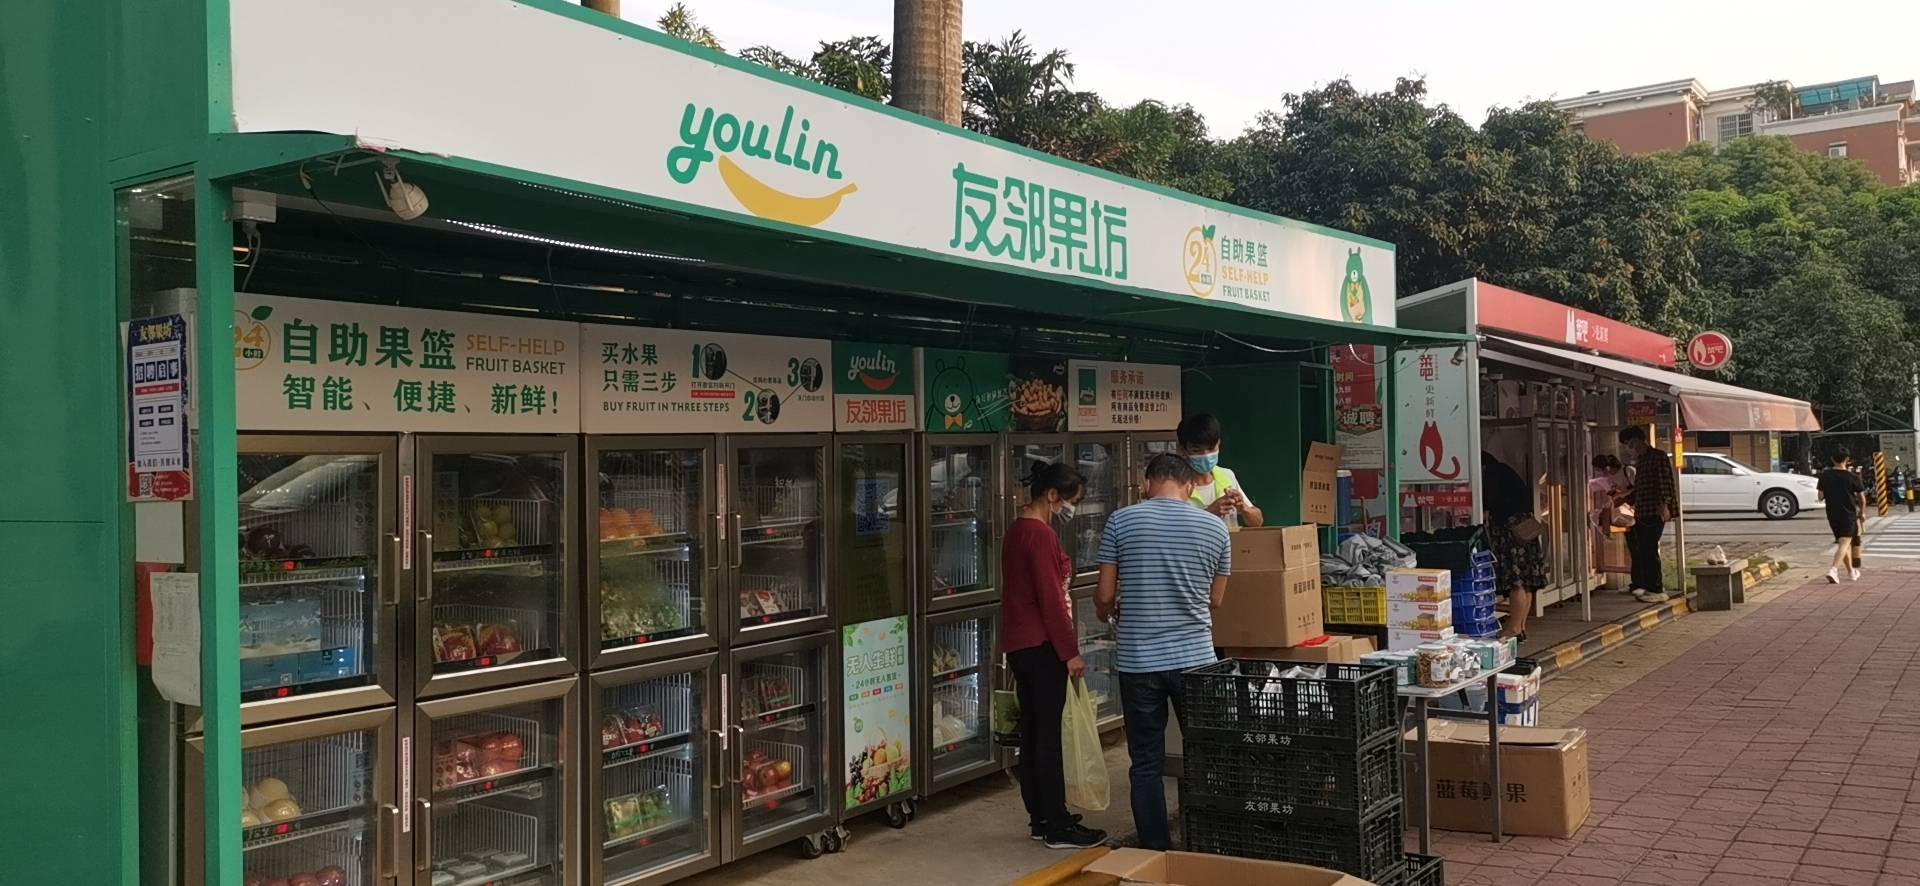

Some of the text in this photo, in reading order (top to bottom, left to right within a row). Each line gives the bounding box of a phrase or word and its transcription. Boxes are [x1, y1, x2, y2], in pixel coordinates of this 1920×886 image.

[667, 103, 842, 184] youlin
[950, 162, 1128, 280] 友邻果坊
[1221, 235, 1269, 268] 自助果篮
[1222, 267, 1270, 286] SELF-HELP
[1222, 285, 1271, 302] FRUIT BASKET
[284, 318, 456, 370] 自助果篮
[466, 334, 565, 356] SELF-HELP
[601, 342, 658, 366] 买水果
[466, 357, 566, 375] FRUIT BASKET
[691, 343, 701, 378] 1
[787, 357, 800, 387] 3
[848, 350, 896, 381] youlin
[1419, 354, 1434, 381] 菜吧
[602, 370, 677, 394] 只需三步
[603, 402, 729, 412] BUY FRUIT IN THREE STEPS
[742, 391, 755, 421] 2
[846, 400, 906, 424] 友邻果坊
[1343, 411, 1376, 425] 诚聘
[1242, 732, 1292, 746] 友邻果坊
[1244, 800, 1294, 815] 友邻果坊
